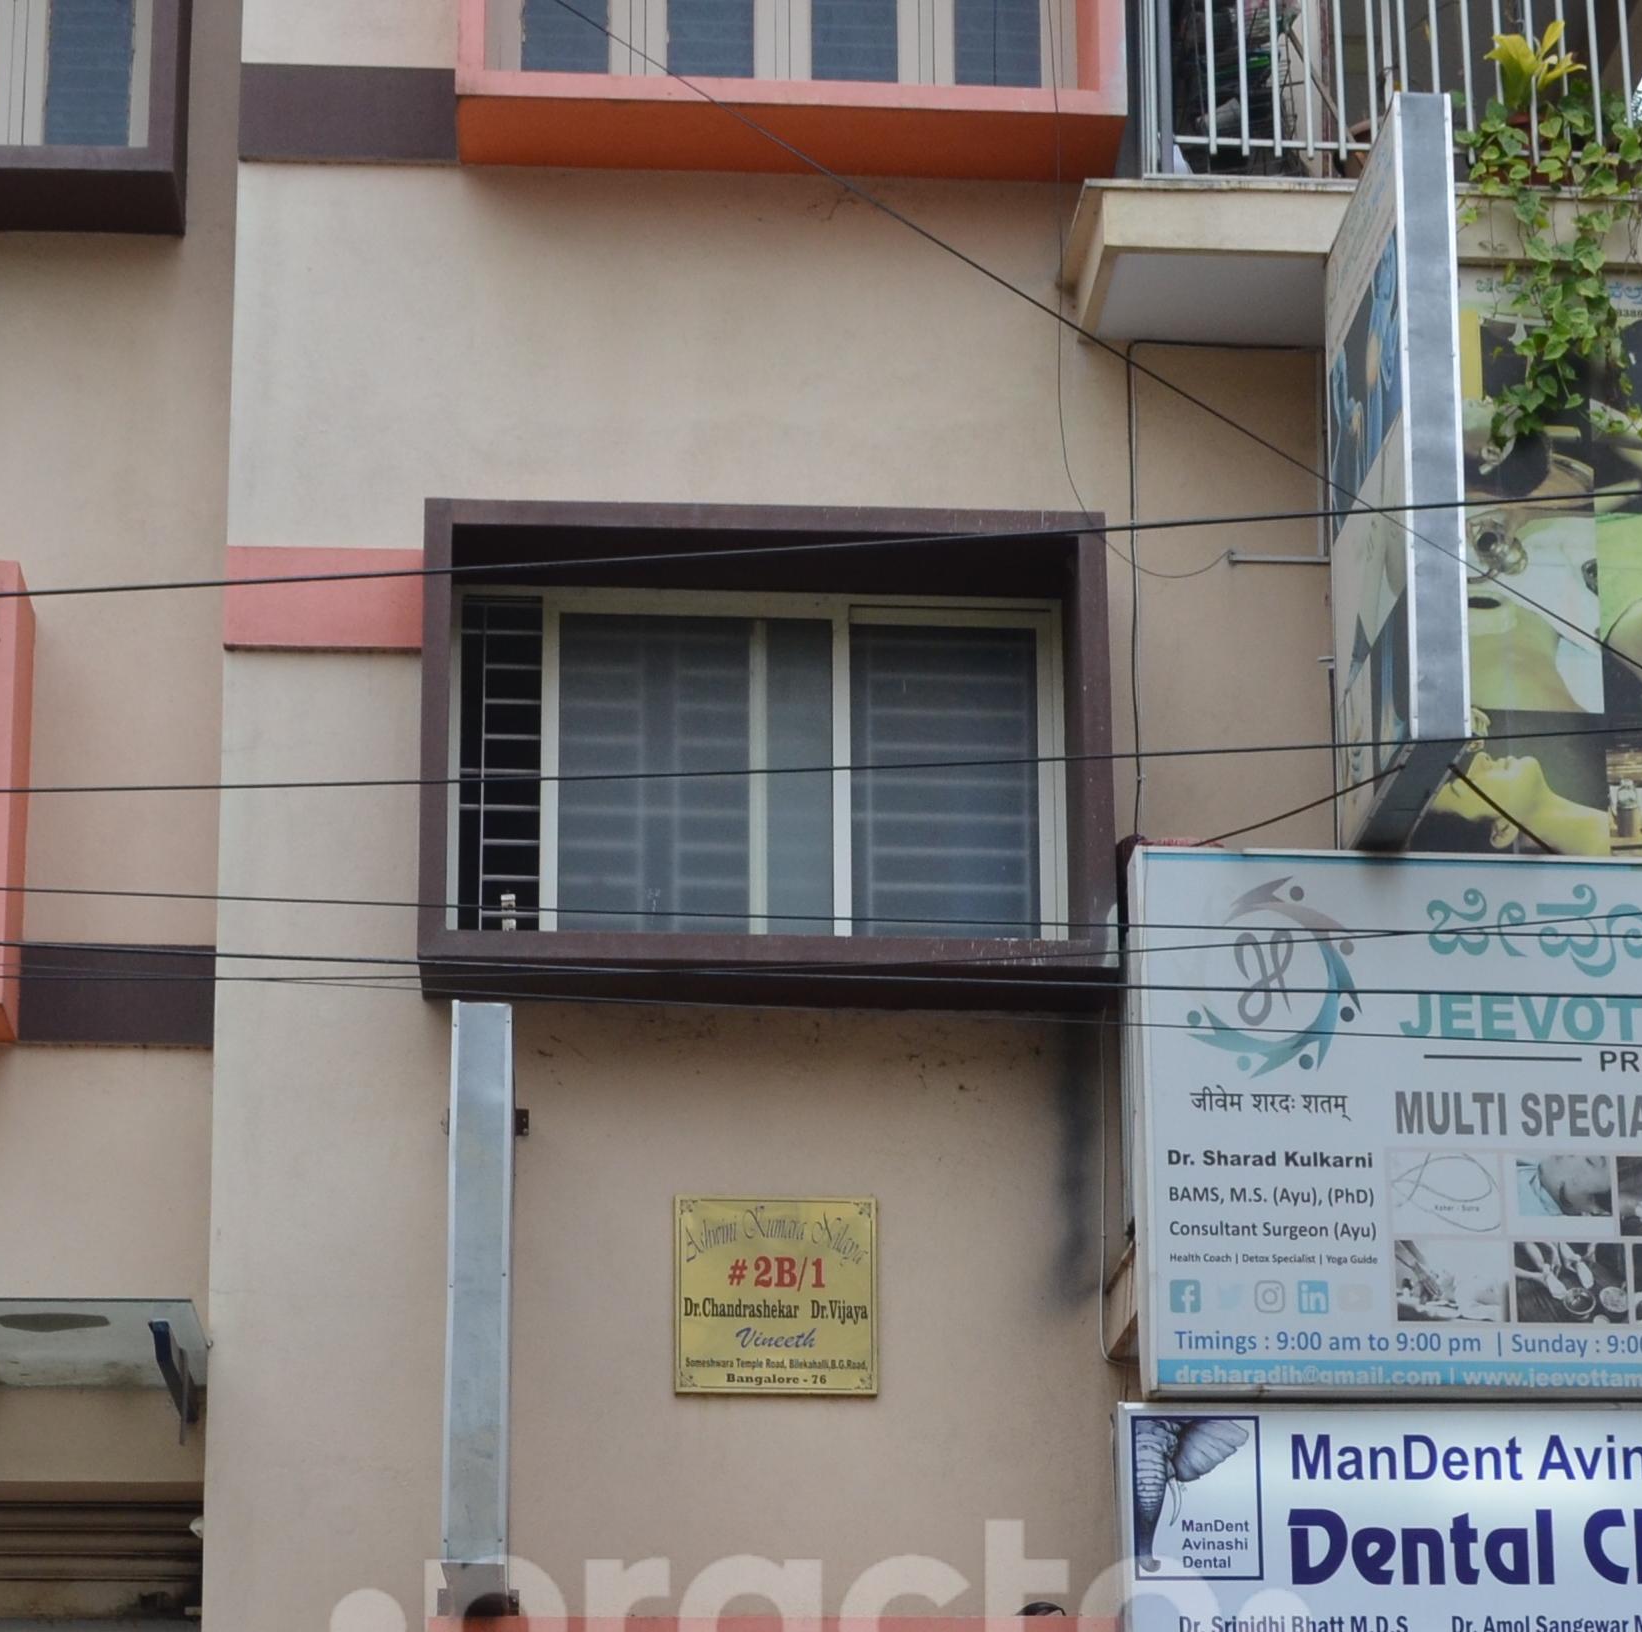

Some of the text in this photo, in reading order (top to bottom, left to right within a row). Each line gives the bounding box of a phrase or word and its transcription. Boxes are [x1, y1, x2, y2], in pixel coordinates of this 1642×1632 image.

[1190, 1086, 1351, 1120] जीवेम शरदः शतम्
[1396, 1090, 1509, 1138] MULTI
[1168, 1150, 1373, 1168] Dr. Sharad Kulkarni
[1170, 1187, 1374, 1207] BAMS, M.S. (Ayu), (PhD)
[1170, 1221, 1377, 1241] Consultant Surgeon (Ayu)
[1170, 1254, 1378, 1265] Health Coach Detox Specialist Yoga Guide
[684, 1298, 868, 1325] Dr.Chandrashekar Dr.Vijaya
[736, 1327, 816, 1348] Vineeth
[1175, 1331, 1256, 1351] Timings
[1277, 1332, 1321, 1351] 9:00
[1397, 1334, 1441, 1352] 9:00
[1449, 1339, 1480, 1357] pm
[1512, 1334, 1587, 1356] Sunday
[686, 1358, 763, 1369] Someshwara Temple
[726, 1374, 826, 1385] Bangalore 76
[1291, 1434, 1523, 1481] ManDent
[1182, 1520, 1249, 1532] ManDent
[1183, 1538, 1248, 1550] Avinashi
[1288, 1508, 1557, 1585] Dental
[1184, 1556, 1231, 1569] Dental
